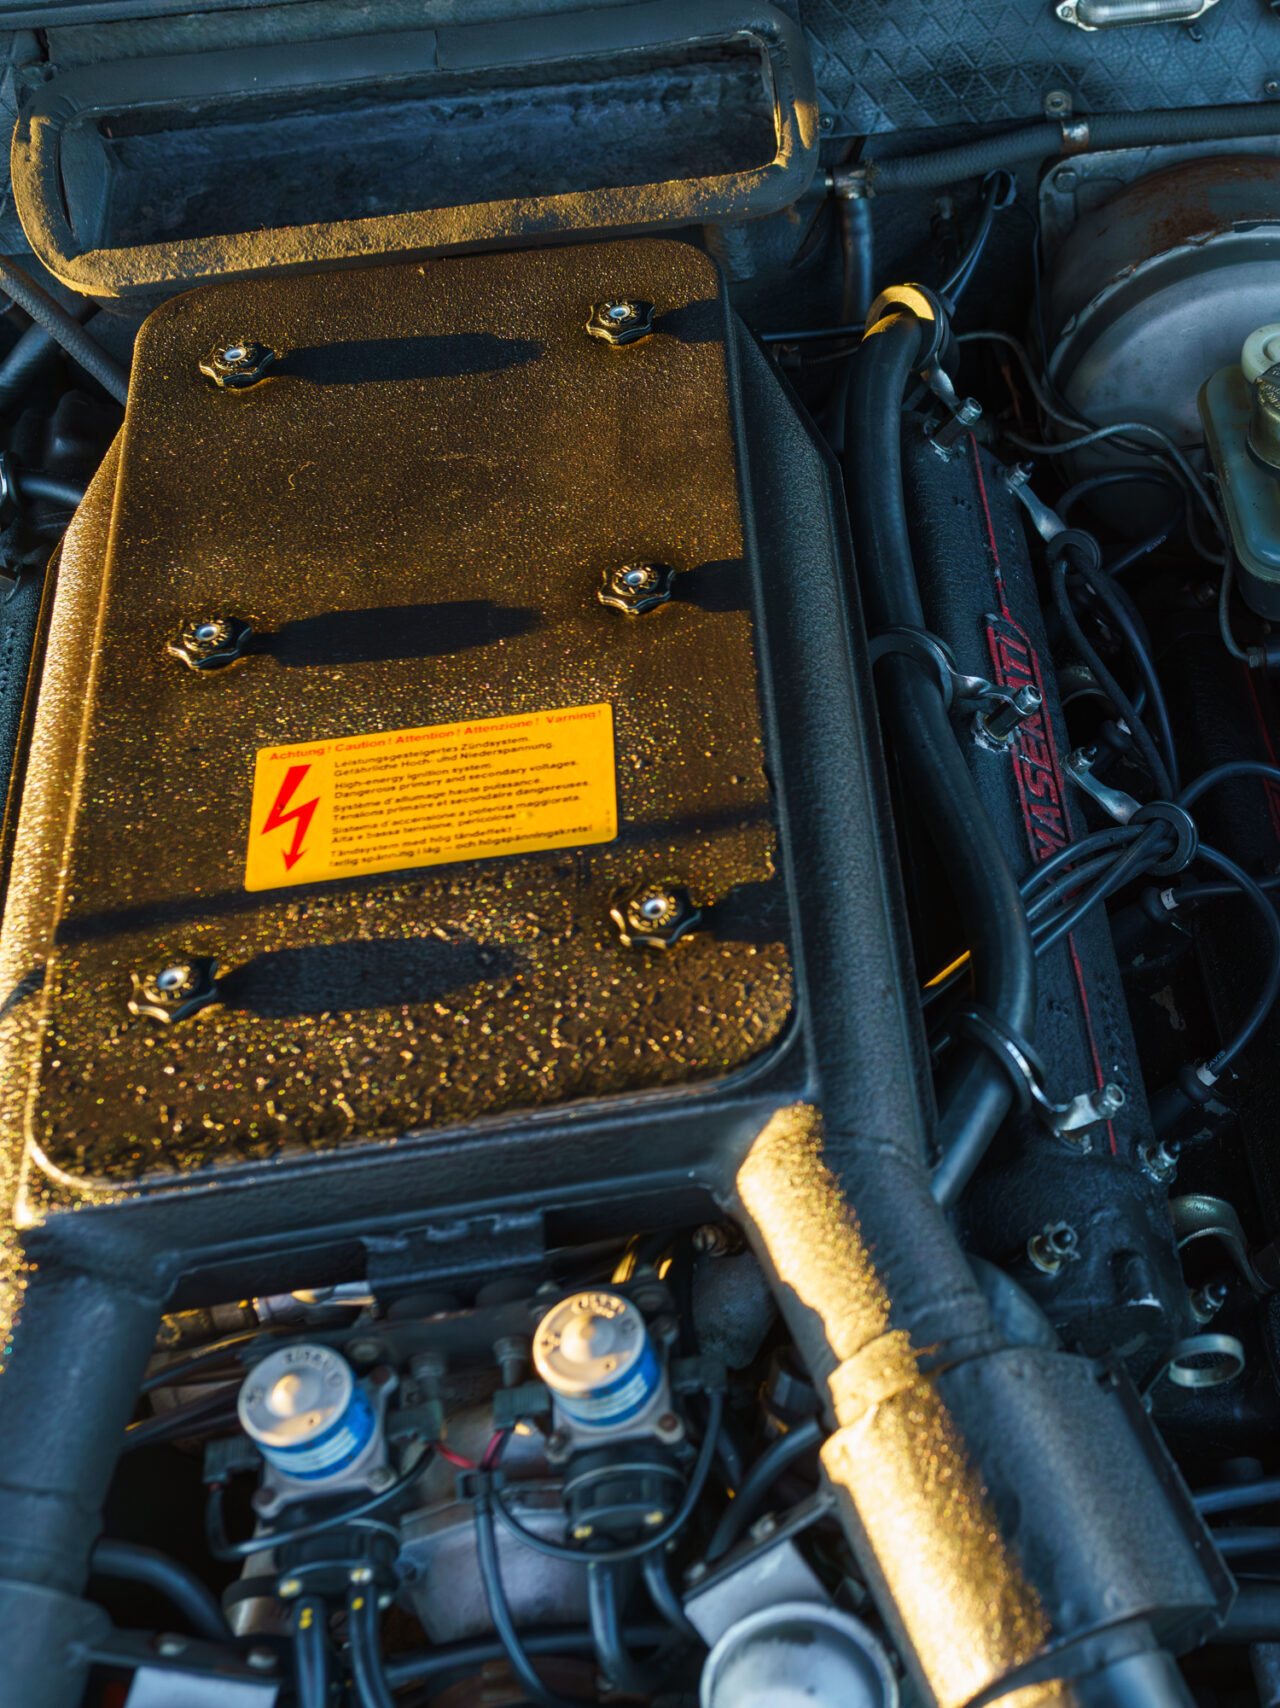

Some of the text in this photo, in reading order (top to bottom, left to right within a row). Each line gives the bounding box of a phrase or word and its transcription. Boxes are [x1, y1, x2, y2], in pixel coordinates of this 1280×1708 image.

[435, 753, 457, 764] und
[333, 783, 396, 799] Dangerous
[398, 777, 442, 791] primary
[444, 774, 466, 784] and
[468, 765, 526, 781] secondary
[334, 773, 403, 790] High-energy
[406, 767, 449, 781] ignition
[448, 785, 480, 797] haute
[332, 807, 384, 821] Tensions
[386, 800, 433, 814] primaire
[436, 799, 447, 807] et
[449, 790, 512, 805] secondaire
[331, 821, 378, 835] Sistema
[458, 809, 465, 817] a
[467, 803, 513, 816] potenza
[366, 828, 400, 839] bassa
[401, 838, 426, 849] med
[455, 840, 476, 851] och
